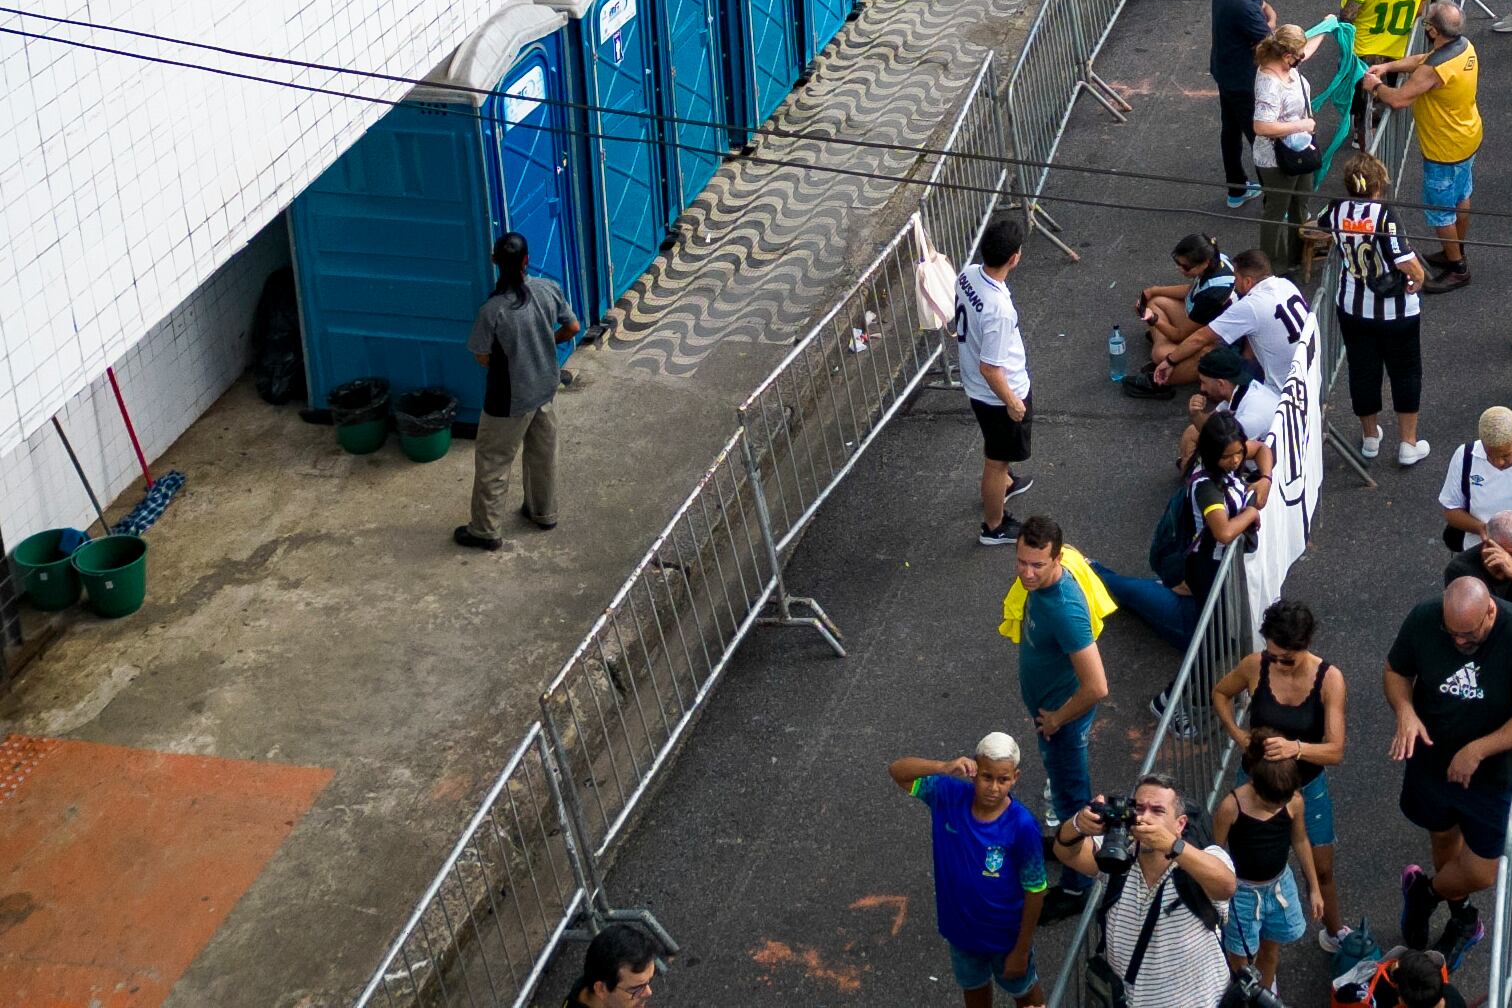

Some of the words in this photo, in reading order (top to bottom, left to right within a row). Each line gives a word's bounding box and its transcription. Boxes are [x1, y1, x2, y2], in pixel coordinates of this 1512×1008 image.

[1369, 0, 1416, 35] 10
[1342, 218, 1374, 233] BMG
[1274, 294, 1310, 344] 10
[1440, 683, 1484, 699] adidas
